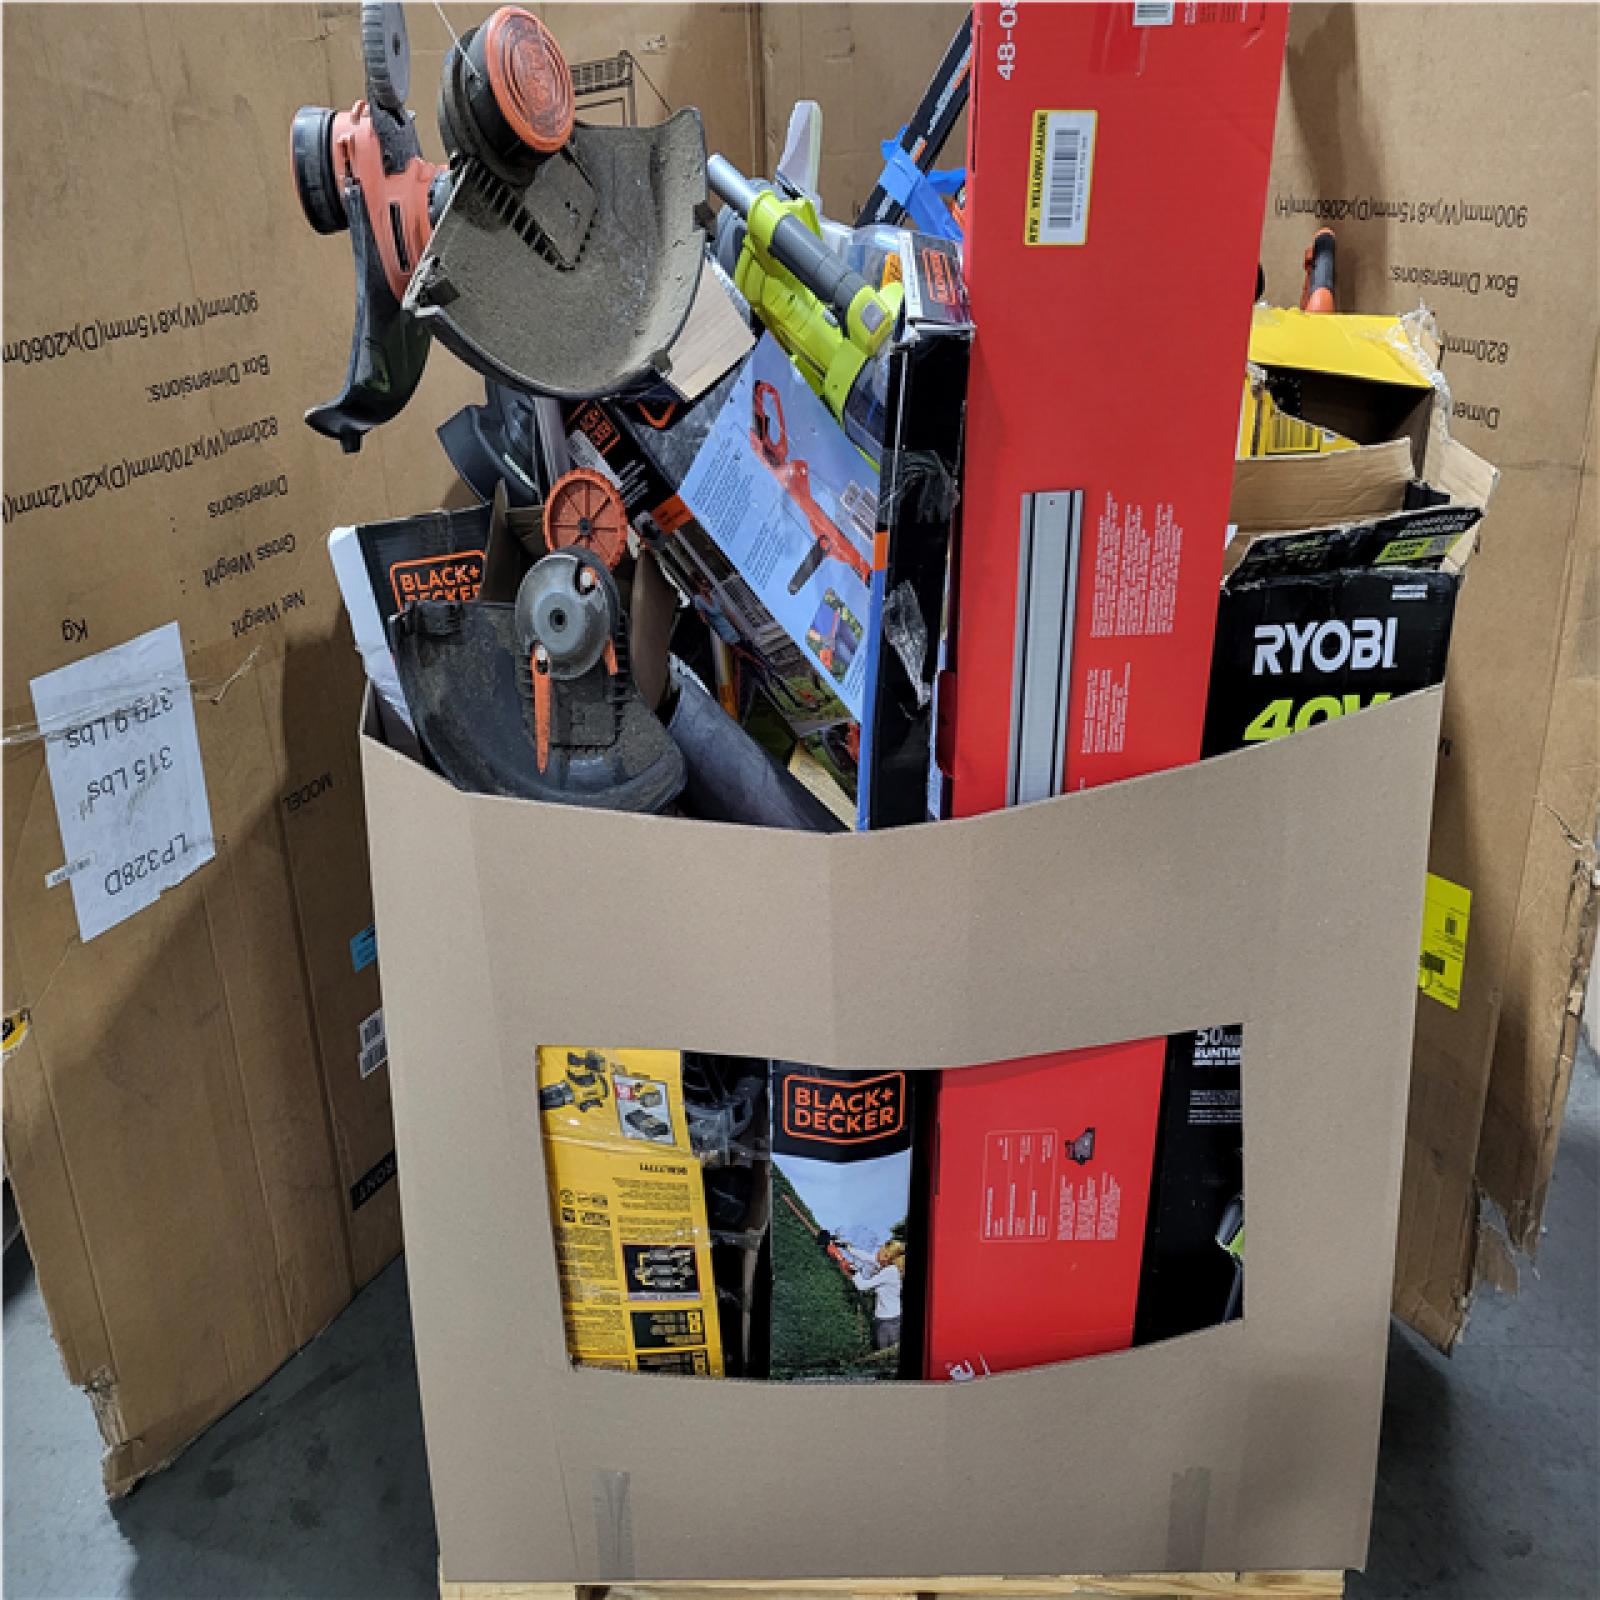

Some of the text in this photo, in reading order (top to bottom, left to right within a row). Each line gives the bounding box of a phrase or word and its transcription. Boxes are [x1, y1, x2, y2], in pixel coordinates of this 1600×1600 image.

[1388, 264, 1519, 298] Box Dimensions:
[243, 354, 270, 376] Box
[207, 474, 288, 518] Dimensions
[202, 533, 296, 588] Gross Weight
[400, 563, 480, 592] BLACK+
[61, 588, 306, 643] Net Weight Kg
[1252, 617, 1398, 675] RYOBI
[65, 716, 110, 749] Lbs
[87, 745, 174, 800] 315 Lbs
[283, 772, 333, 814] MODEL
[104, 832, 189, 896] LP328D
[795, 1087, 895, 1112] BLACK+
[795, 1106, 895, 1133] DECKER
